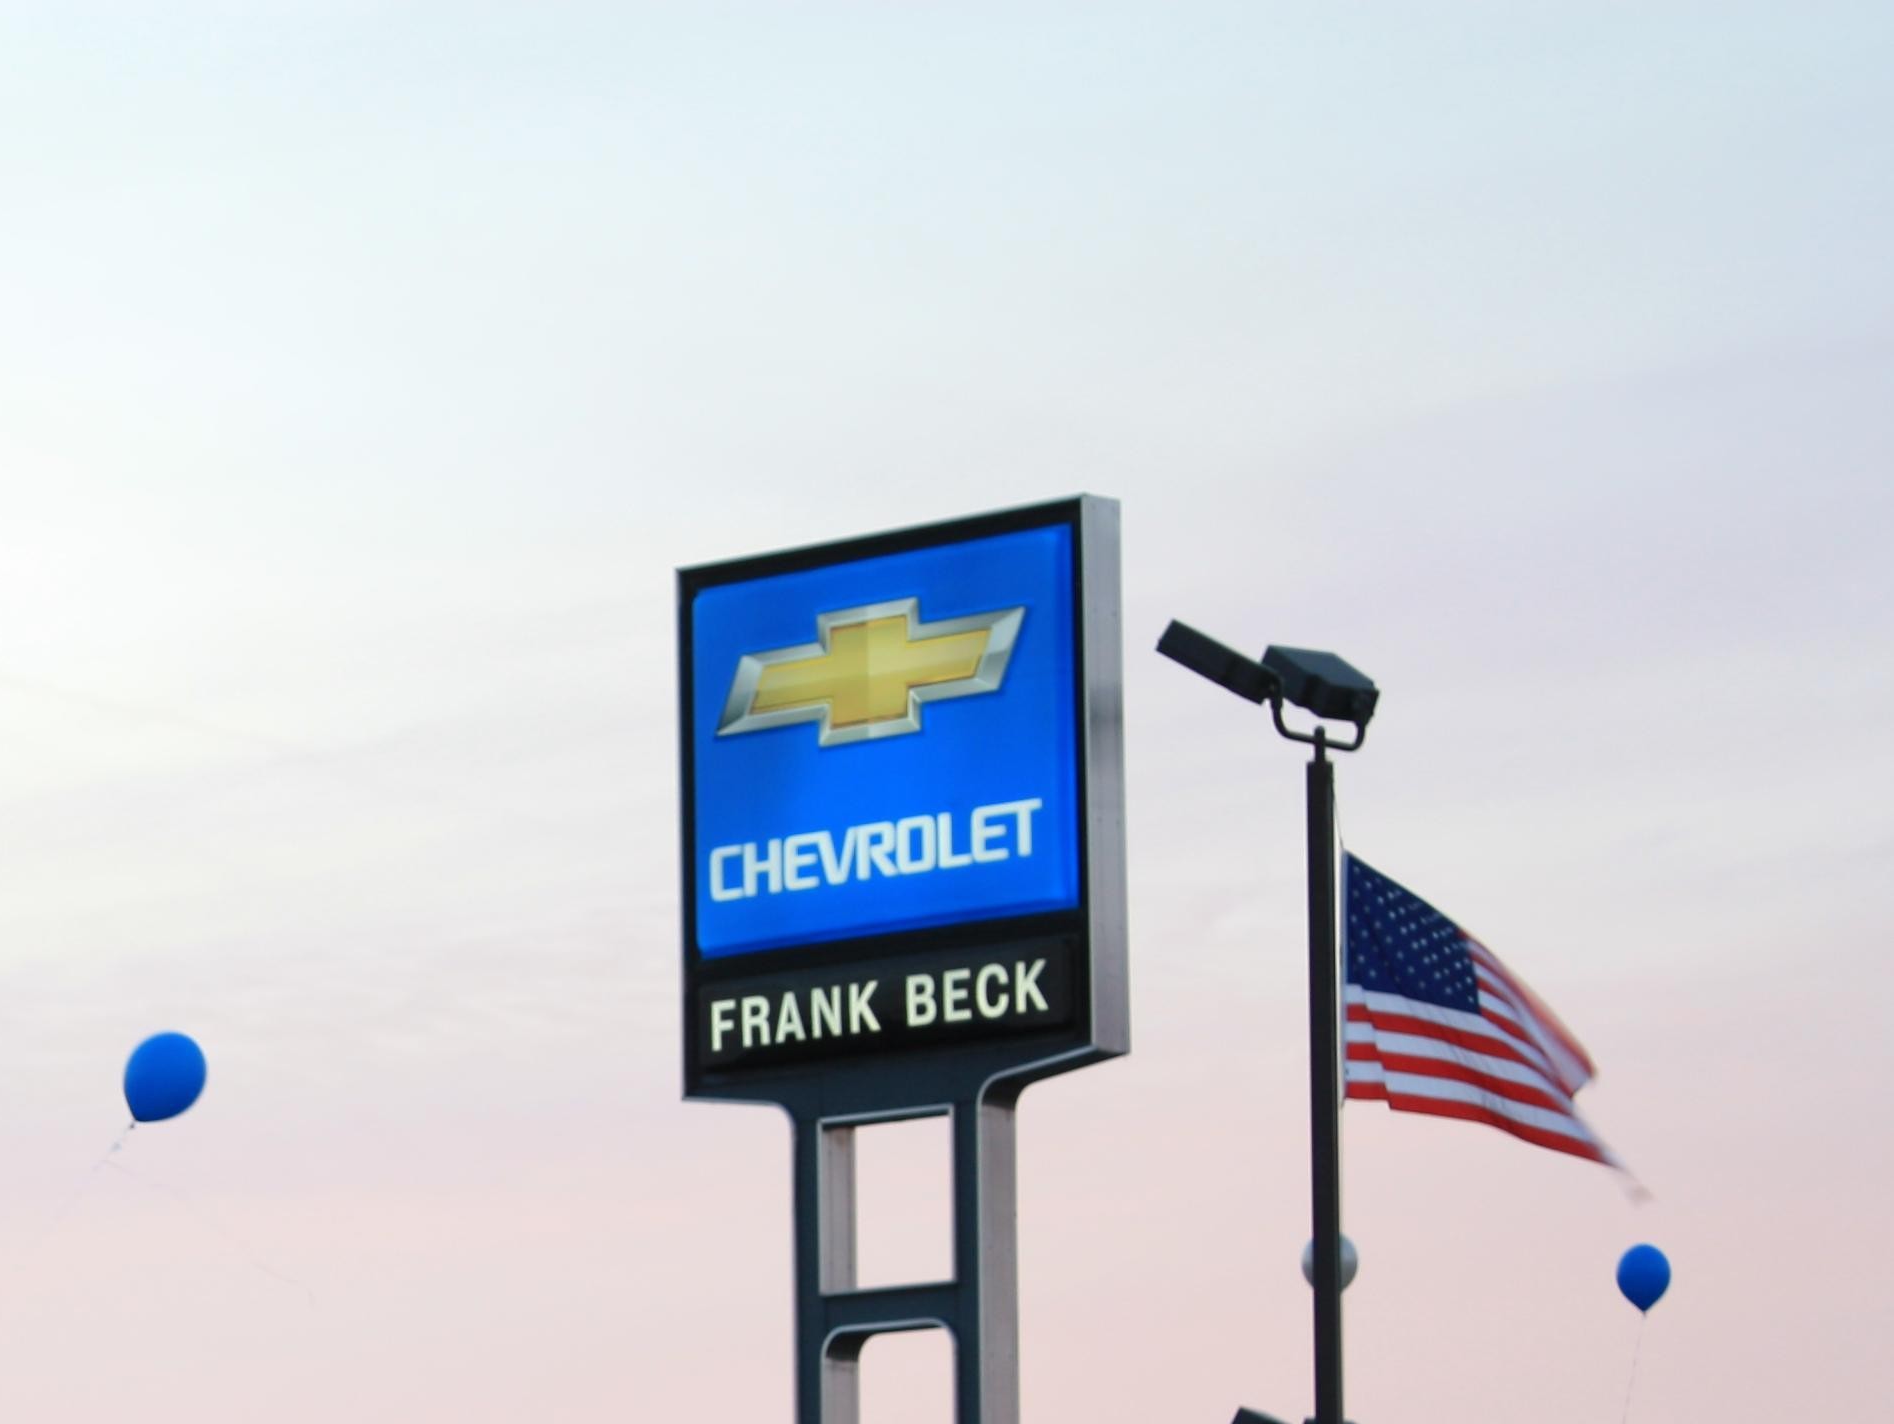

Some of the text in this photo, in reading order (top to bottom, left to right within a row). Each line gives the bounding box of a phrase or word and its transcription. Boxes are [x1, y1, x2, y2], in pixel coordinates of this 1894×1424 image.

[709, 798, 1043, 902] CHEVROLET
[710, 958, 1049, 1052] FRANK BECK
